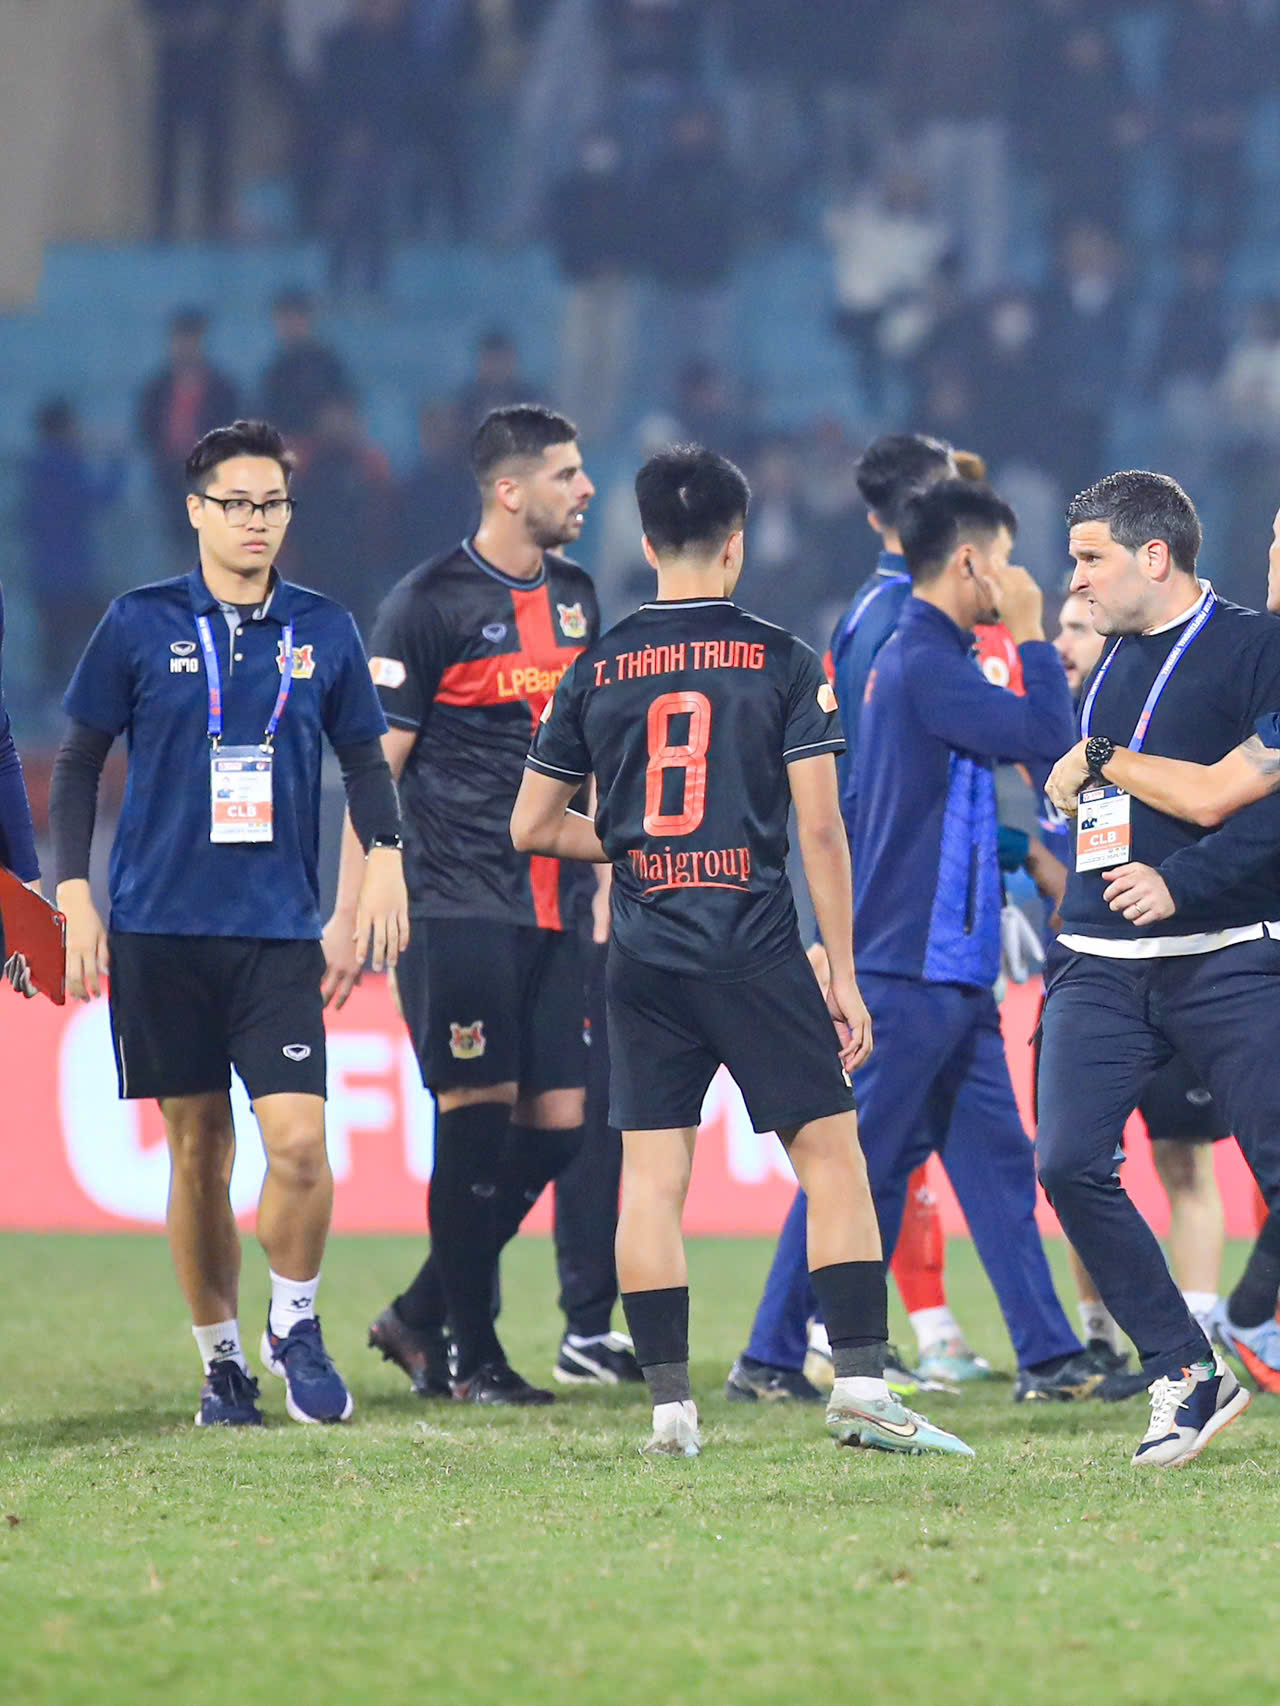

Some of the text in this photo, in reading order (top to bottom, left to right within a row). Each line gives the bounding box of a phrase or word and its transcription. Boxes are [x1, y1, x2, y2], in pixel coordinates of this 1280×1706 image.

[497, 663, 568, 697] LPBan
[594, 641, 765, 686] T. THÀNH TRUNG
[643, 691, 712, 837] 8
[227, 805, 257, 818] CLB
[1090, 831, 1117, 847] CLB
